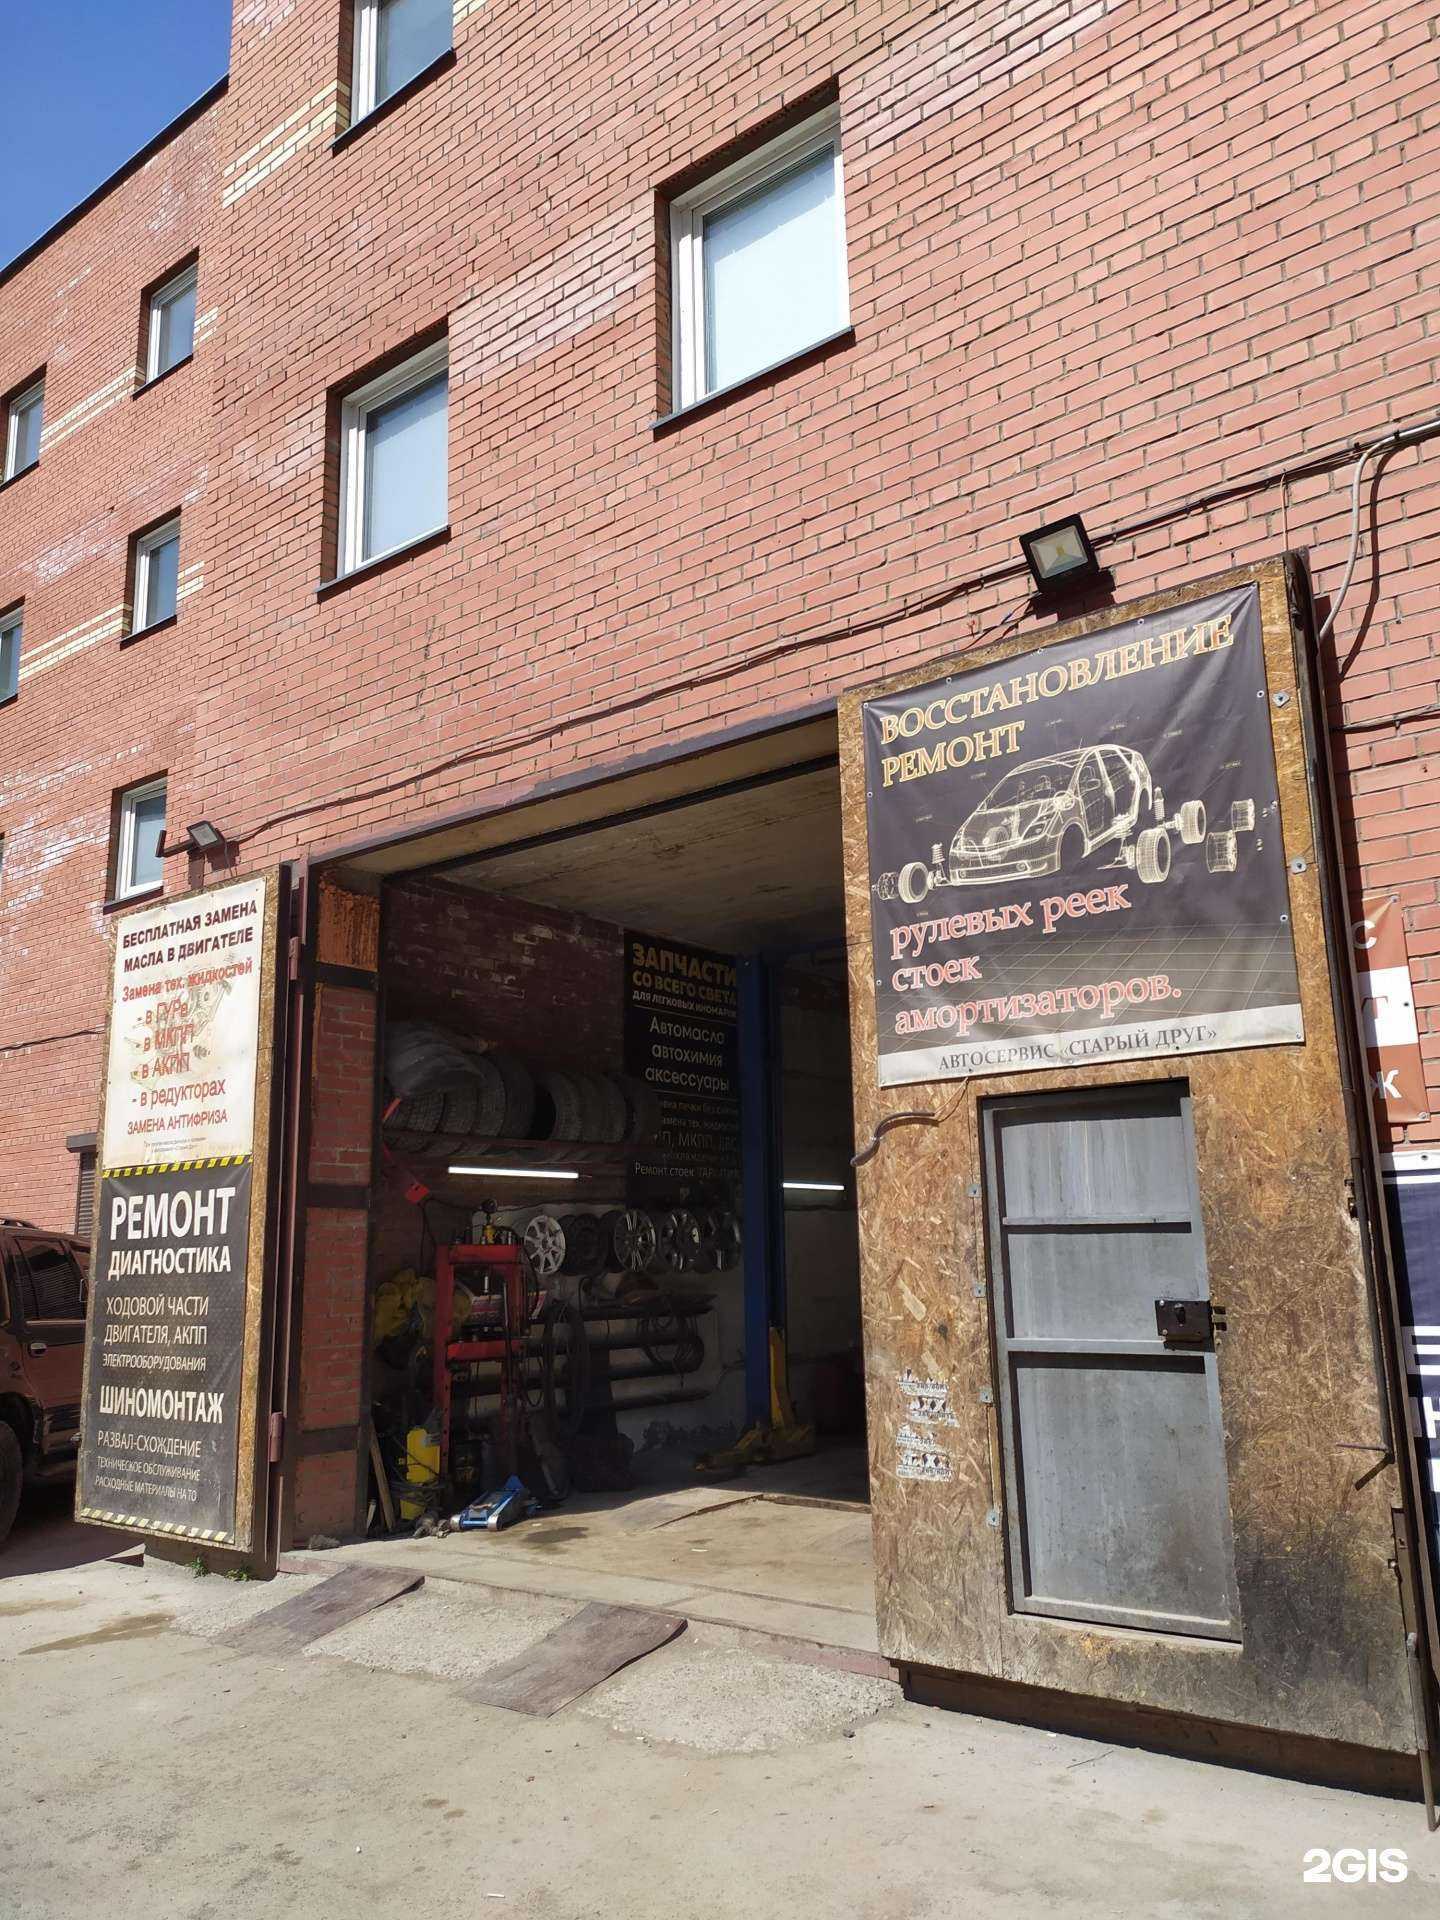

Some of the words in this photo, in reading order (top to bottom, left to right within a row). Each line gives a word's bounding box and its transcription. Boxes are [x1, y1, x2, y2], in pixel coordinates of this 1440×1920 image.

[880, 613, 1235, 745] ВОССТАНОВЛЕНИЕ
[882, 720, 1026, 787] РЕМОНТ
[123, 914, 201, 949] БЕСПЛАТНАЯ
[204, 900, 258, 928] ЗАМЕНА
[890, 900, 1032, 961] рулевых
[1041, 881, 1132, 933] реек
[124, 951, 164, 973] МАСЛА
[167, 948, 175, 962] В
[178, 927, 254, 960] ДВИГАТЕЛЕ
[632, 942, 736, 986] ЗАПЧАСТИ
[122, 980, 162, 1002] Замена
[187, 960, 253, 987] жидкостей
[632, 969, 652, 988] СО
[654, 975, 696, 998] ВСЕГО
[892, 953, 983, 992] стоек
[894, 973, 1183, 1037] амортизаторов.
[649, 1016, 725, 1045] Автомасло
[152, 1053, 190, 1077] АКПП
[651, 1043, 723, 1068] автохимия
[938, 1043, 1055, 1072] АВТОСЕРВИС
[1061, 1029, 1151, 1060] «СТАРЫЙ
[1155, 1024, 1218, 1050] ДРУГ»
[150, 1079, 227, 1111] редукторах
[645, 1066, 729, 1092] аксессуары
[127, 1115, 165, 1135] ЗАМЕНА
[167, 1108, 228, 1132] АНТИФРИЗА
[110, 1186, 236, 1241] РЕМОНТ
[108, 1245, 232, 1281] ДИАГНОСТИКА
[106, 1293, 165, 1319] ХОДОВОЙ
[167, 1294, 209, 1316] ЧАСТИ
[104, 1323, 171, 1349] ДВИГАТЕЛЯ,
[173, 1325, 208, 1346] АКПП
[102, 1352, 206, 1373] ЭЛЕКТРООБОРУДОВАНИЯ
[99, 1384, 225, 1424] ШИНОМОНТАЖ
[97, 1429, 202, 1459] РАЗВАЛ-СХОЖДЕНИЕ
[96, 1455, 142, 1474] ТЕХНИЧЕСКОЕ
[142, 1461, 201, 1482] ОБСЛУЖИВАНИЕ
[94, 1474, 134, 1492] РАСХОДНЫЕ
[134, 1480, 176, 1498] МАТЕРИАЛЫ
[176, 1487, 186, 1500] НА
[187, 1488, 198, 1502] ТО
